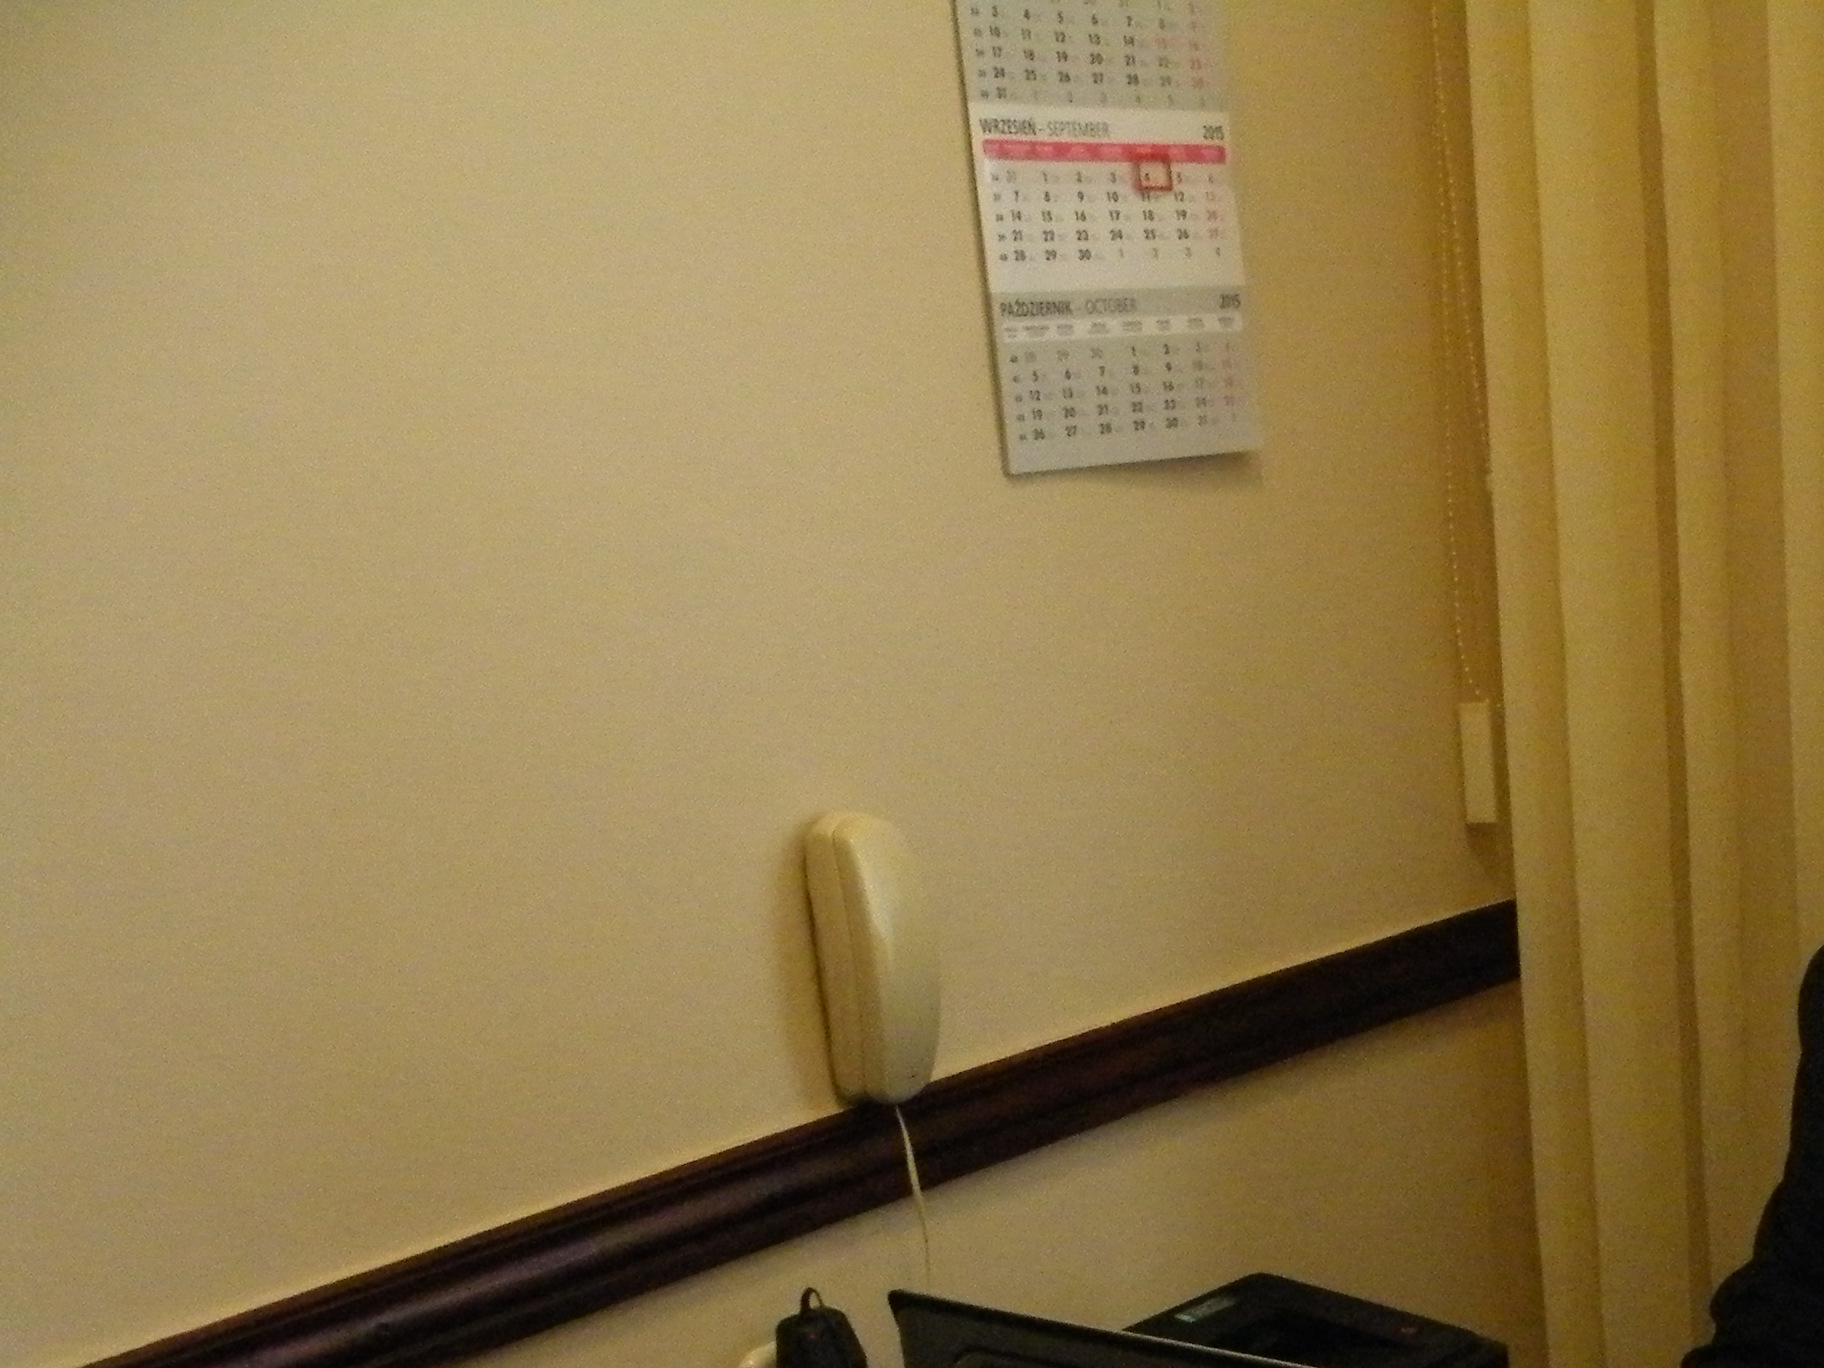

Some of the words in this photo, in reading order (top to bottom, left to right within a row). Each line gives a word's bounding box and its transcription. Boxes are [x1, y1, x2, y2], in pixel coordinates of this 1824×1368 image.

[1054, 31, 1066, 43] 12
[1087, 33, 1101, 45] 13
[1122, 35, 1135, 47] 14
[1055, 50, 1068, 62] 19
[1124, 54, 1136, 66] 21
[1057, 71, 1071, 83] 26
[1125, 73, 1140, 85] 28
[1203, 125, 1226, 141] 2015
[1106, 191, 1119, 203] 10
[1173, 191, 1185, 203] 12
[1010, 209, 1022, 222] 14
[1074, 210, 1087, 222] 16
[1108, 209, 1121, 222] 17
[1142, 209, 1155, 222] 18
[1175, 209, 1188, 222] 19
[1012, 229, 1023, 242] 21
[1075, 229, 1090, 242] 23
[1109, 229, 1124, 241] 24
[1143, 228, 1156, 241] 25
[1176, 228, 1190, 241] 26
[1078, 248, 1093, 262] 30
[1029, 390, 1041, 402] 12
[1162, 381, 1175, 392] 16
[1031, 407, 1043, 420] 19
[1064, 424, 1077, 437] 27
